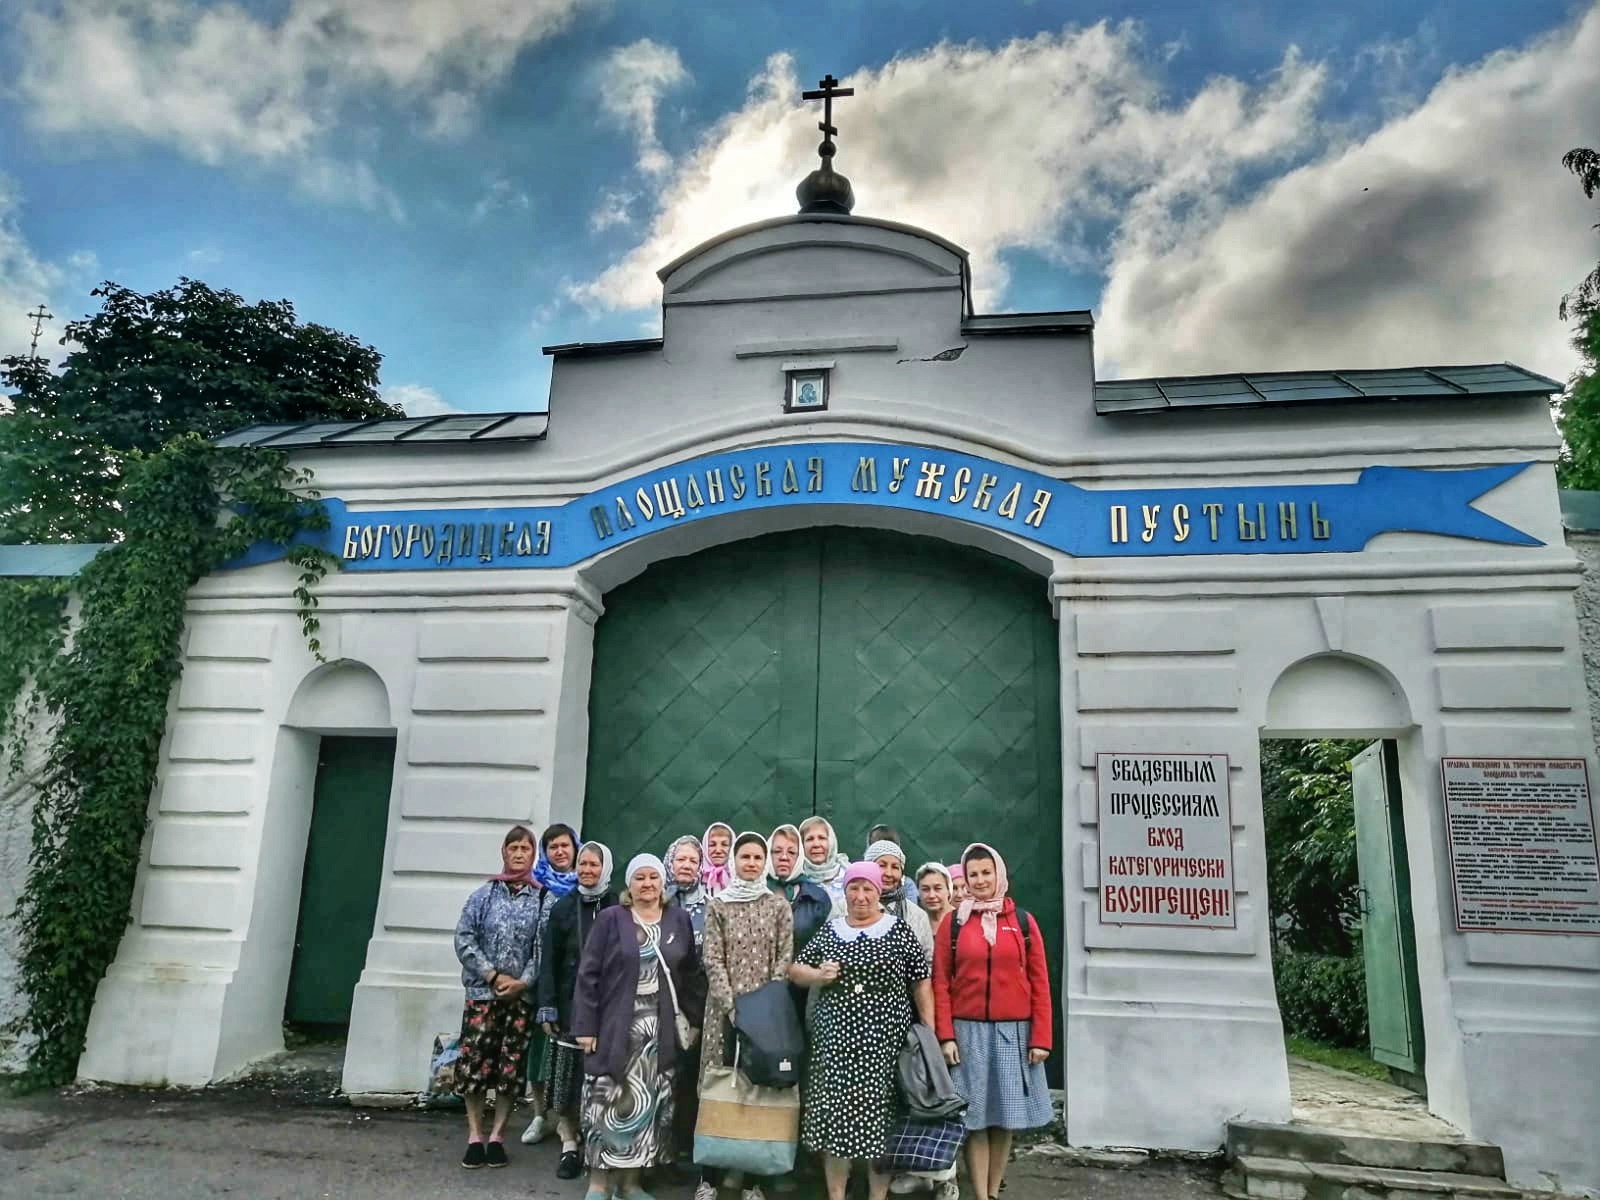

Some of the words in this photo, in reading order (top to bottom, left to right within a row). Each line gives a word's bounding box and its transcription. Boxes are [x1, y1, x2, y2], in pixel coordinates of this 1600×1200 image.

[343, 520, 551, 565] БОГОРОДИЦКАЯ
[590, 456, 824, 540] ПЛОЩАНСКАЯ
[851, 456, 1053, 528] МУЖСКАЯ
[1111, 501, 1331, 543] ПУСТЫНЬ
[1112, 759, 1217, 786] СВАДЕБНЫМ
[1111, 792, 1220, 819] ПРОЦЕССИЯМ
[1148, 826, 1184, 852] ВХОД
[1109, 855, 1225, 878] КАТЕГОРИЧЕСКИ
[1105, 885, 1231, 920] ВОСПРЕЩЕН!
